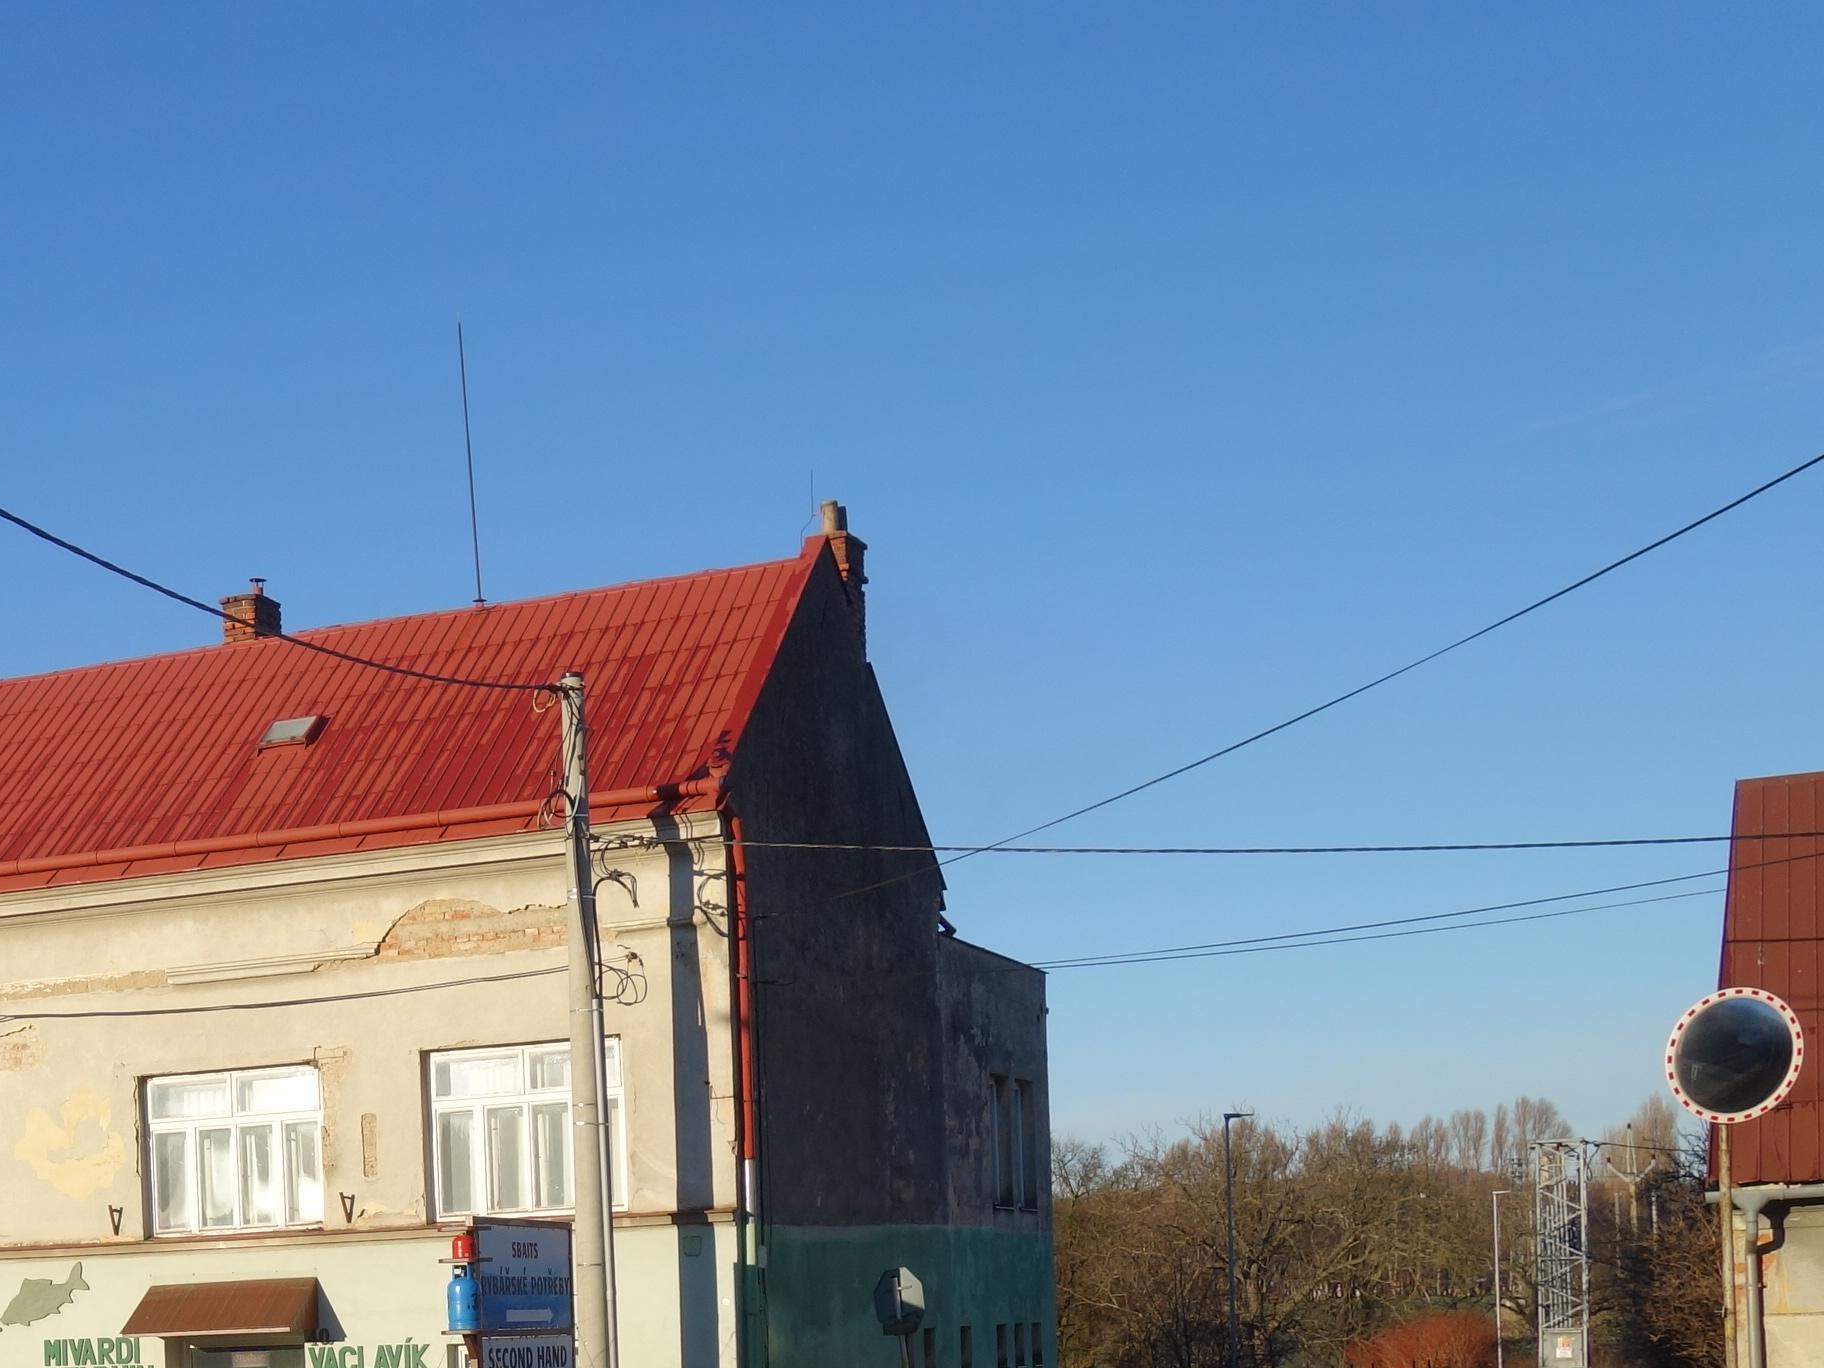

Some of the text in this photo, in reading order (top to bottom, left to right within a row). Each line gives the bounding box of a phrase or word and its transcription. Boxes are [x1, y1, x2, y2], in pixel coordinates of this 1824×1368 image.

[511, 1241, 539, 1259] SBAITS
[481, 1265, 571, 1297] RYBÁŘSKÉ POTŘEBY
[44, 1337, 141, 1366] MIVARDI
[536, 1345, 567, 1368] HAND
